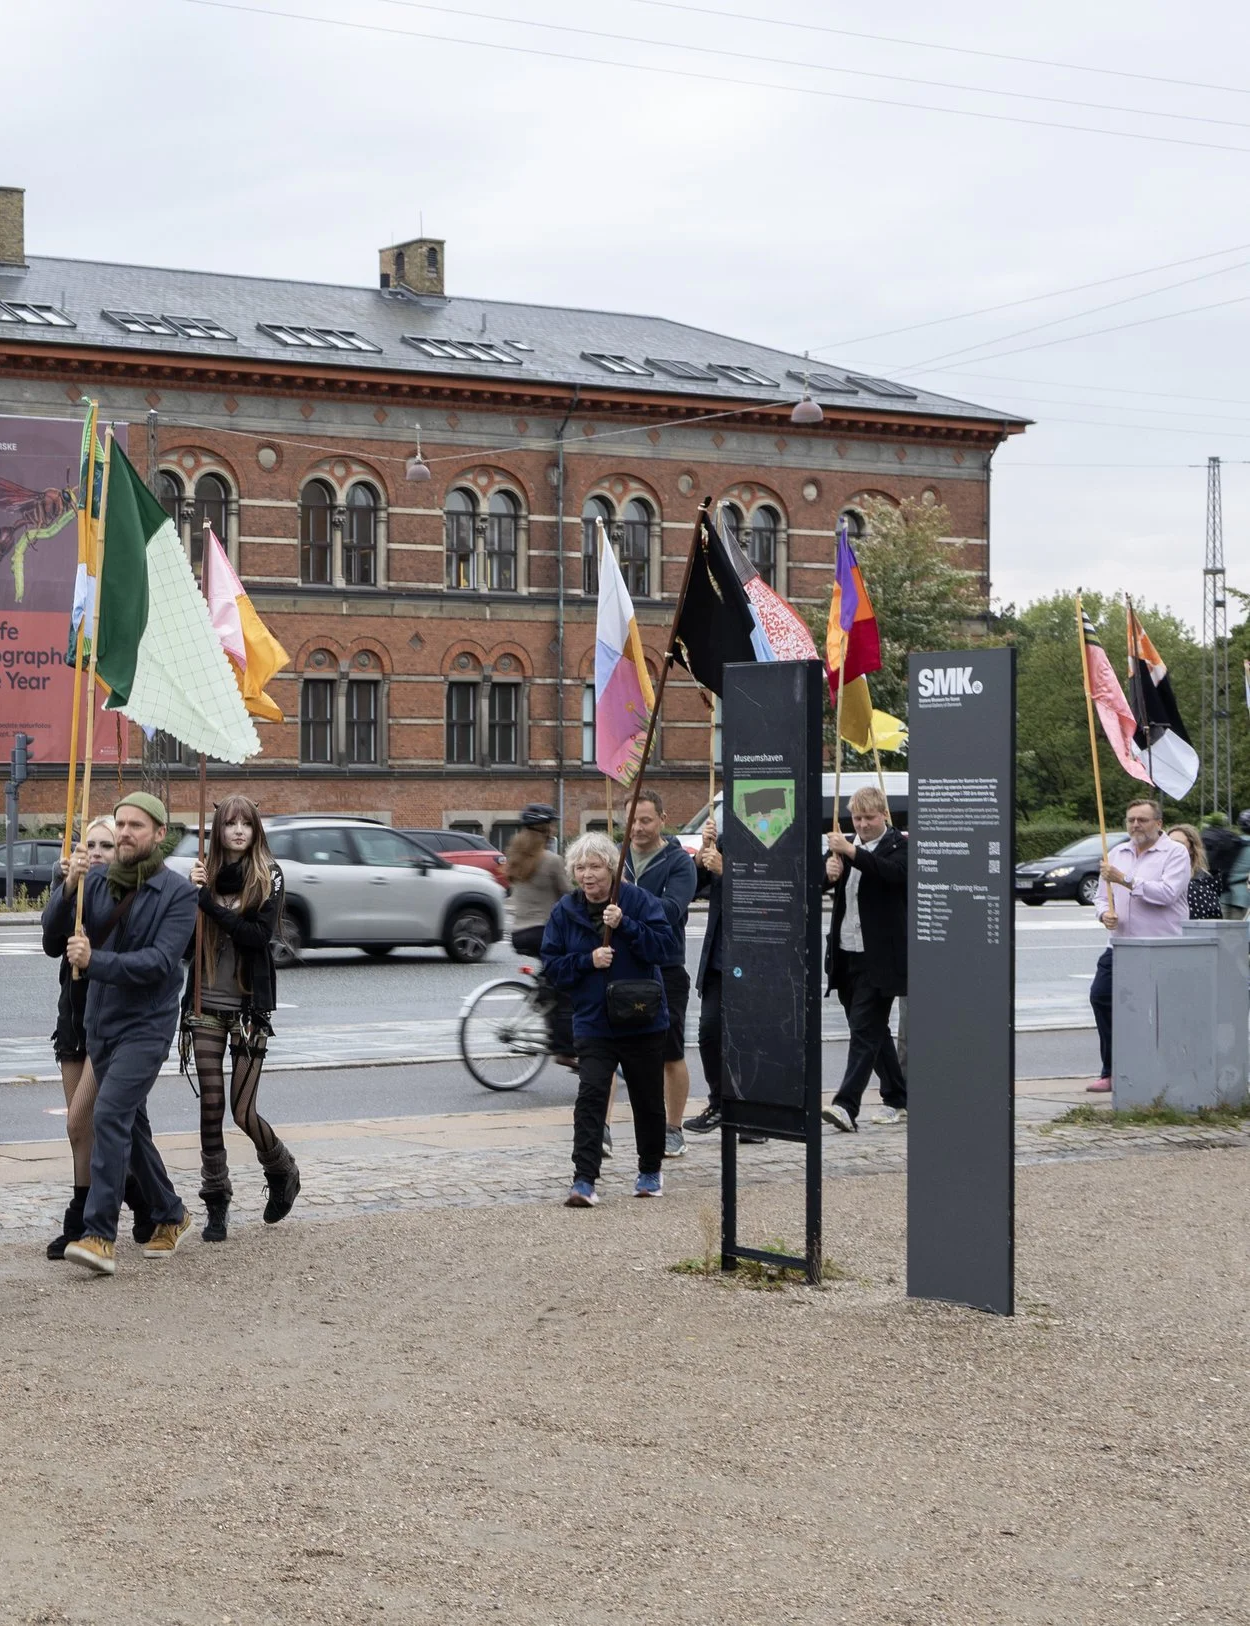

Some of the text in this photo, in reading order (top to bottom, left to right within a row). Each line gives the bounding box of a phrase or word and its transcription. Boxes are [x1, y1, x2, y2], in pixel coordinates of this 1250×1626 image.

[6, 671, 50, 690] Year
[918, 667, 973, 697] SMK
[733, 753, 784, 762] Museumshaven
